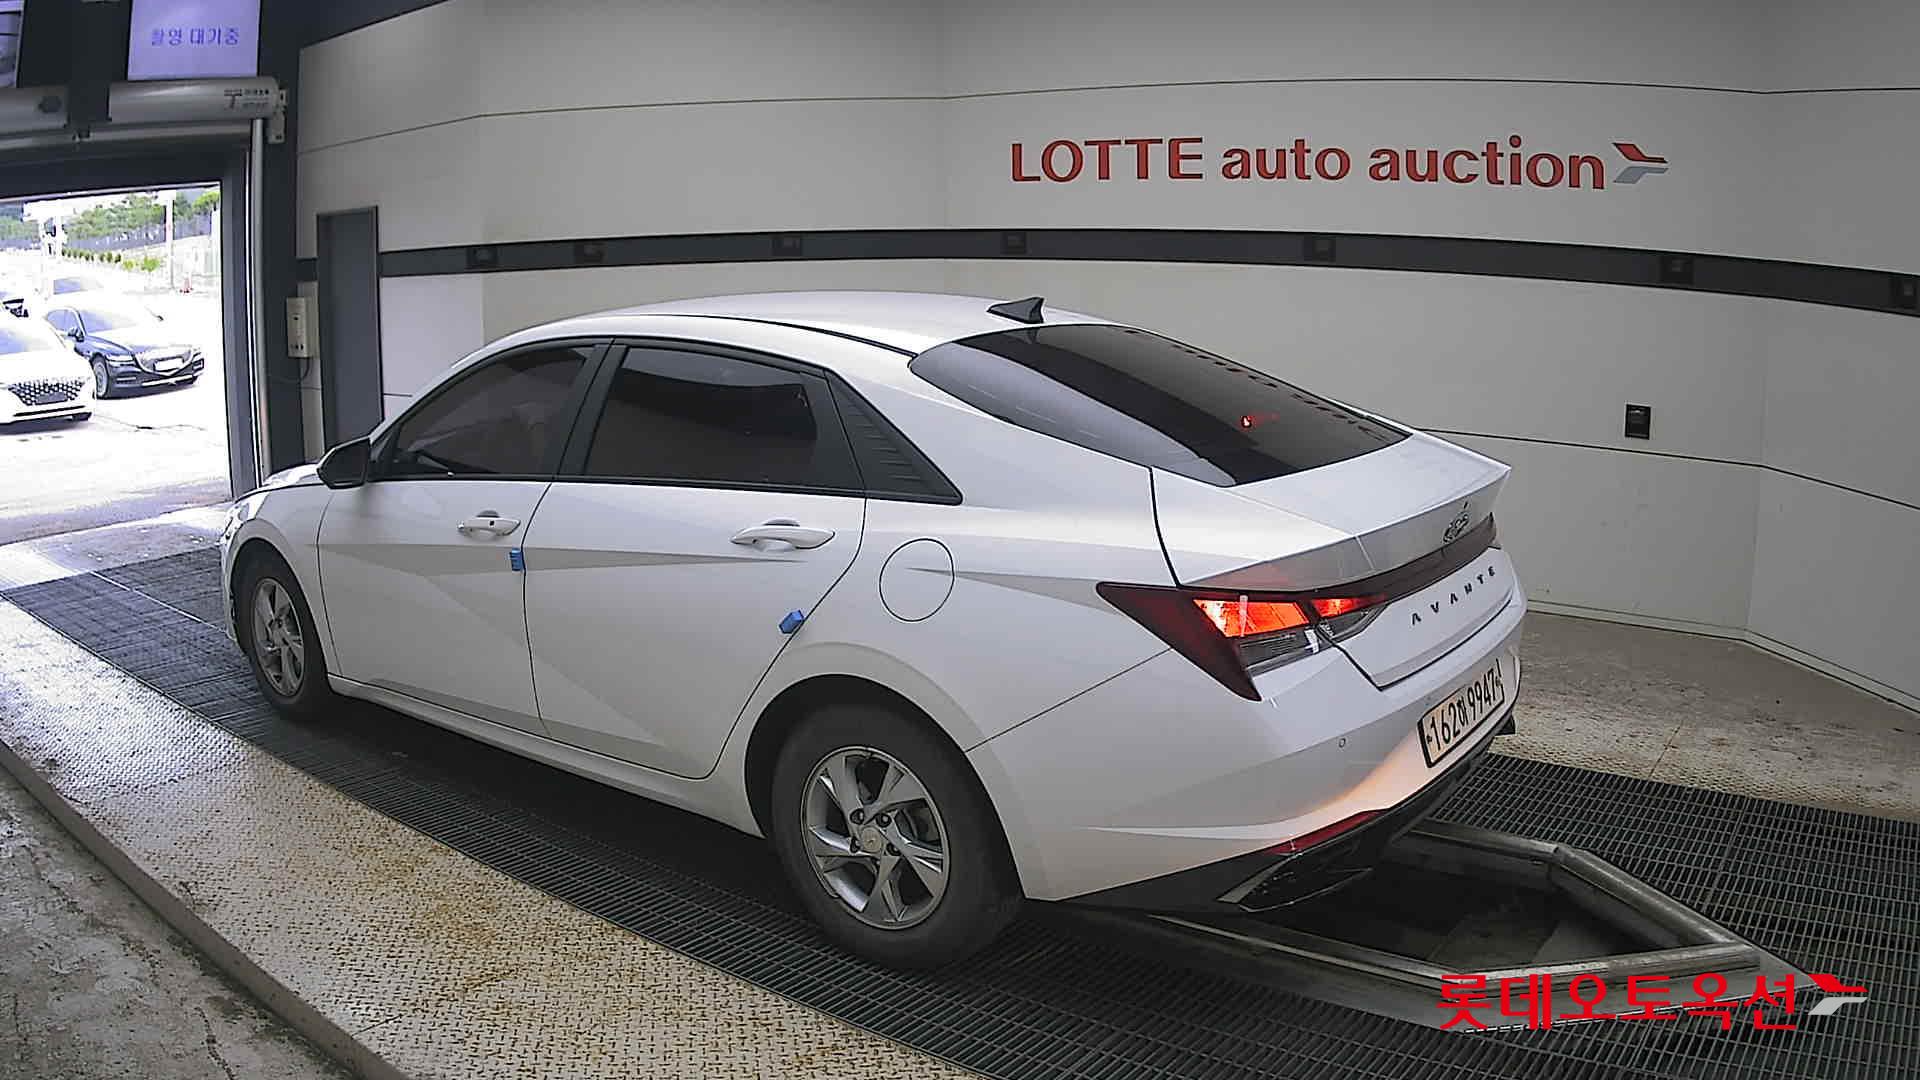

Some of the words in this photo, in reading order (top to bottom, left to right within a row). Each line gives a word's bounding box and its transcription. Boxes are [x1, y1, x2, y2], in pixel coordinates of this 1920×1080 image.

[190, 27, 240, 46] 대기중
[1011, 138, 1203, 182] LOTTE
[1221, 138, 1351, 182] auto
[1368, 136, 1605, 190] auction
[1411, 566, 1495, 625] AVANTE
